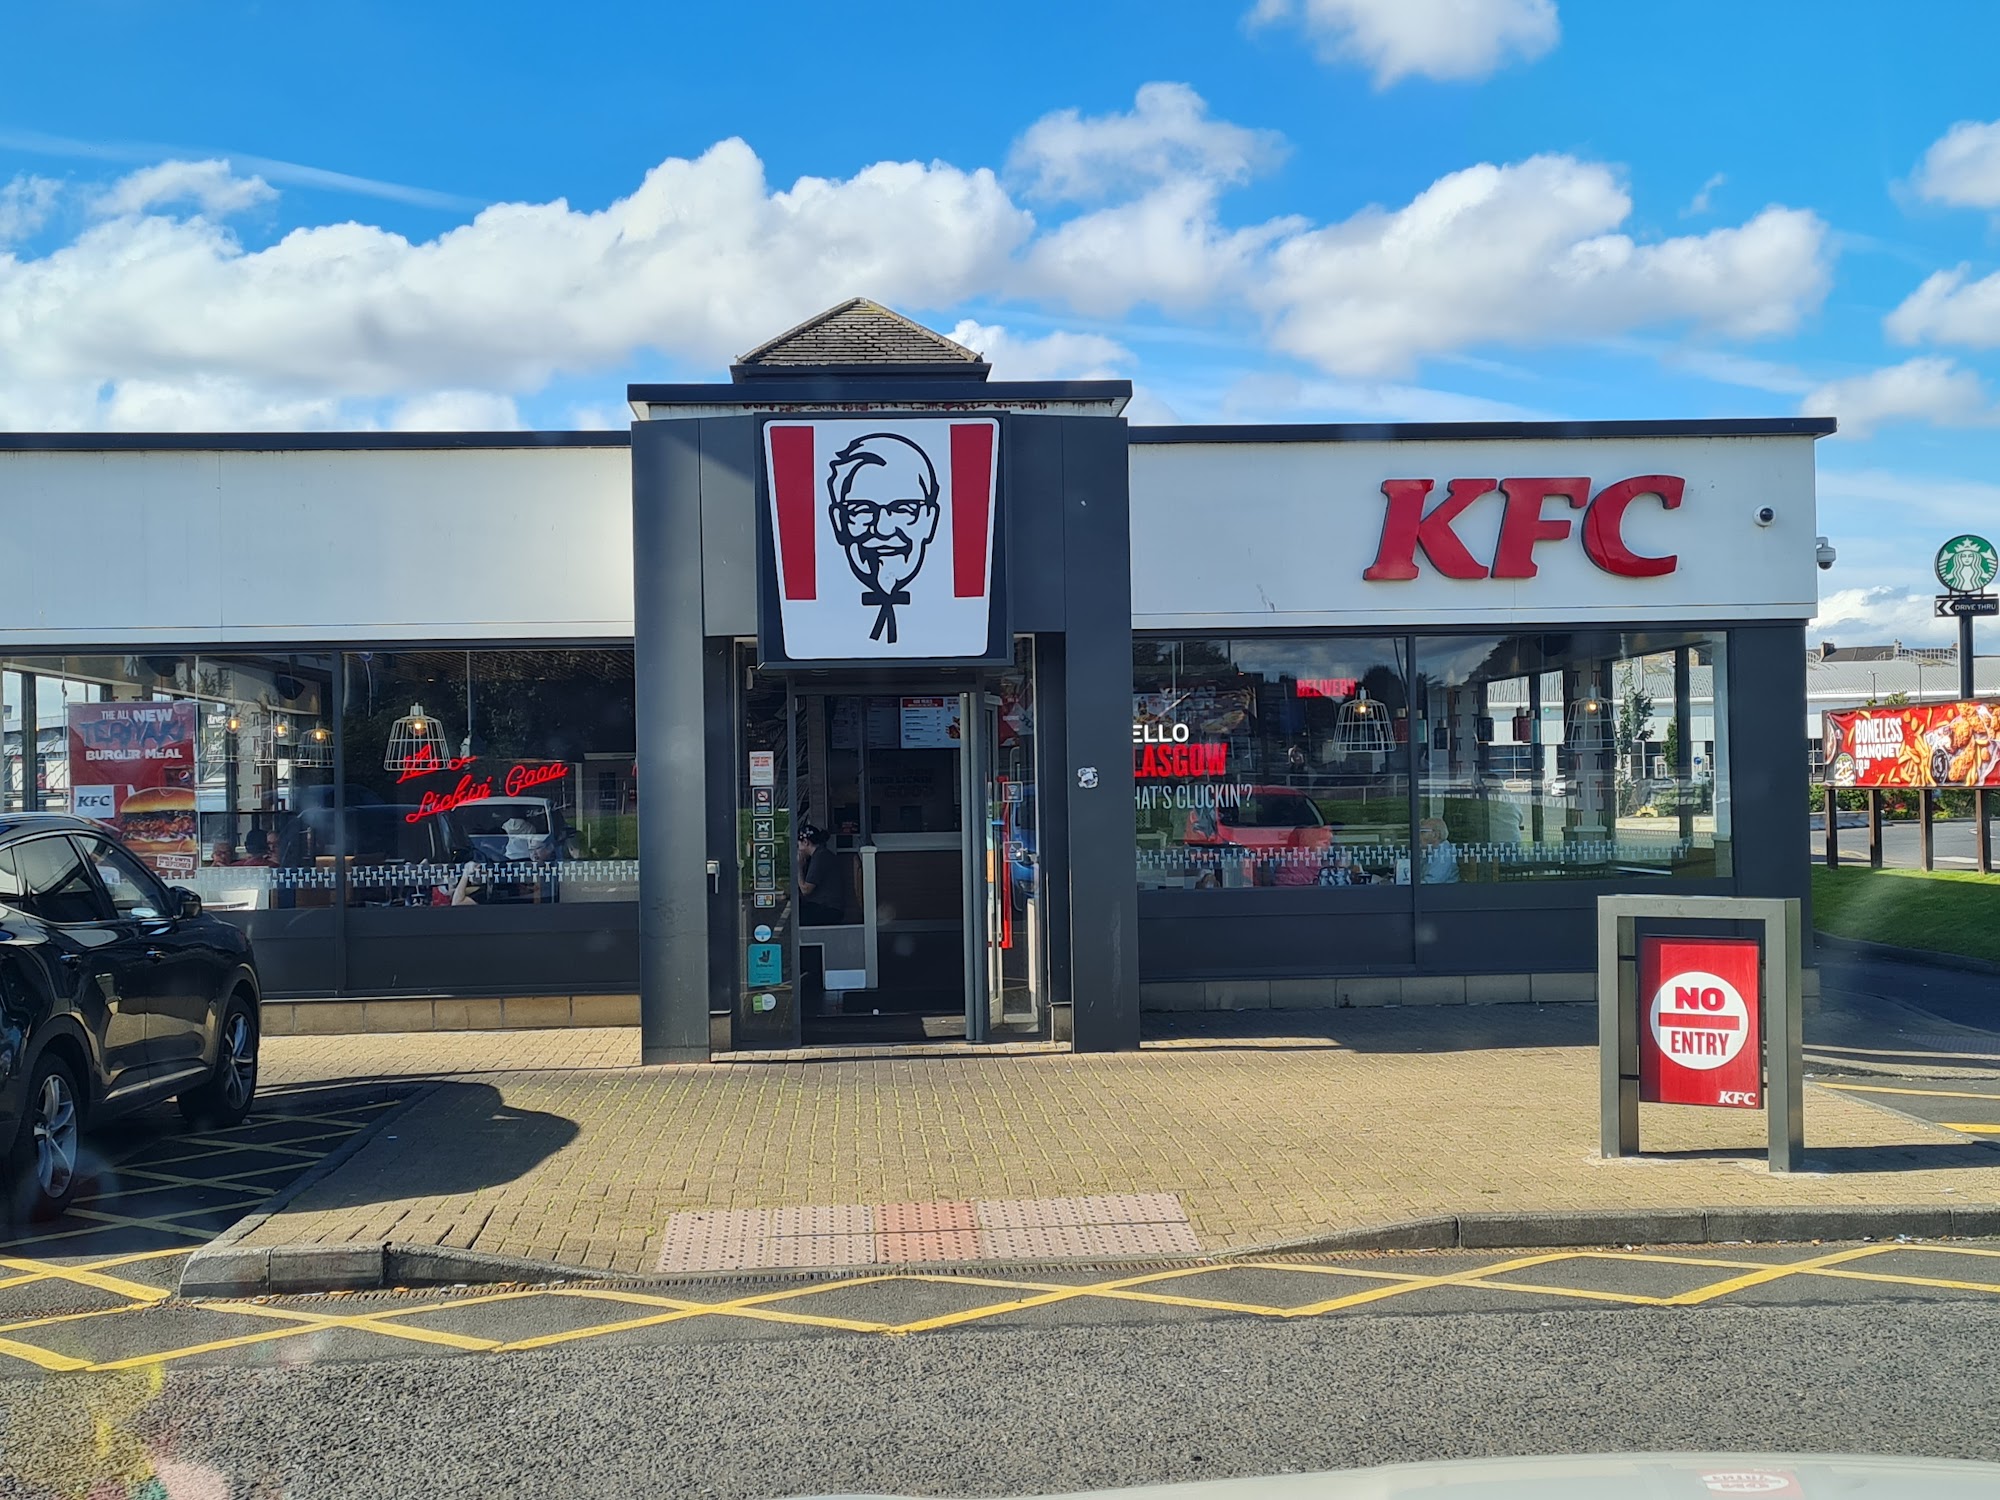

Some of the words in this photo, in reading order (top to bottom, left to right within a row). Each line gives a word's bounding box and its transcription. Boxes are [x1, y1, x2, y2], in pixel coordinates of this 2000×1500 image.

[1362, 474, 1686, 581] KFC
[1296, 678, 1358, 698] DELIVERY
[101, 710, 116, 721] THE
[117, 710, 130, 720] ALL
[133, 708, 173, 722] NEW
[1132, 723, 1190, 743] ELLO
[1855, 717, 1904, 744] BONELESS
[86, 749, 143, 761] BURGER
[145, 748, 183, 760] MEAL
[1133, 743, 1228, 778] LASGOW
[1855, 743, 1902, 761] BANQUET
[76, 795, 112, 807] KFC
[1134, 785, 1172, 809] HAT'S
[1176, 783, 1253, 809] CLUCKIN'?
[1675, 986, 1726, 1012] NO
[1671, 1030, 1730, 1057] ENTRY
[1718, 1091, 1756, 1106] KFC
